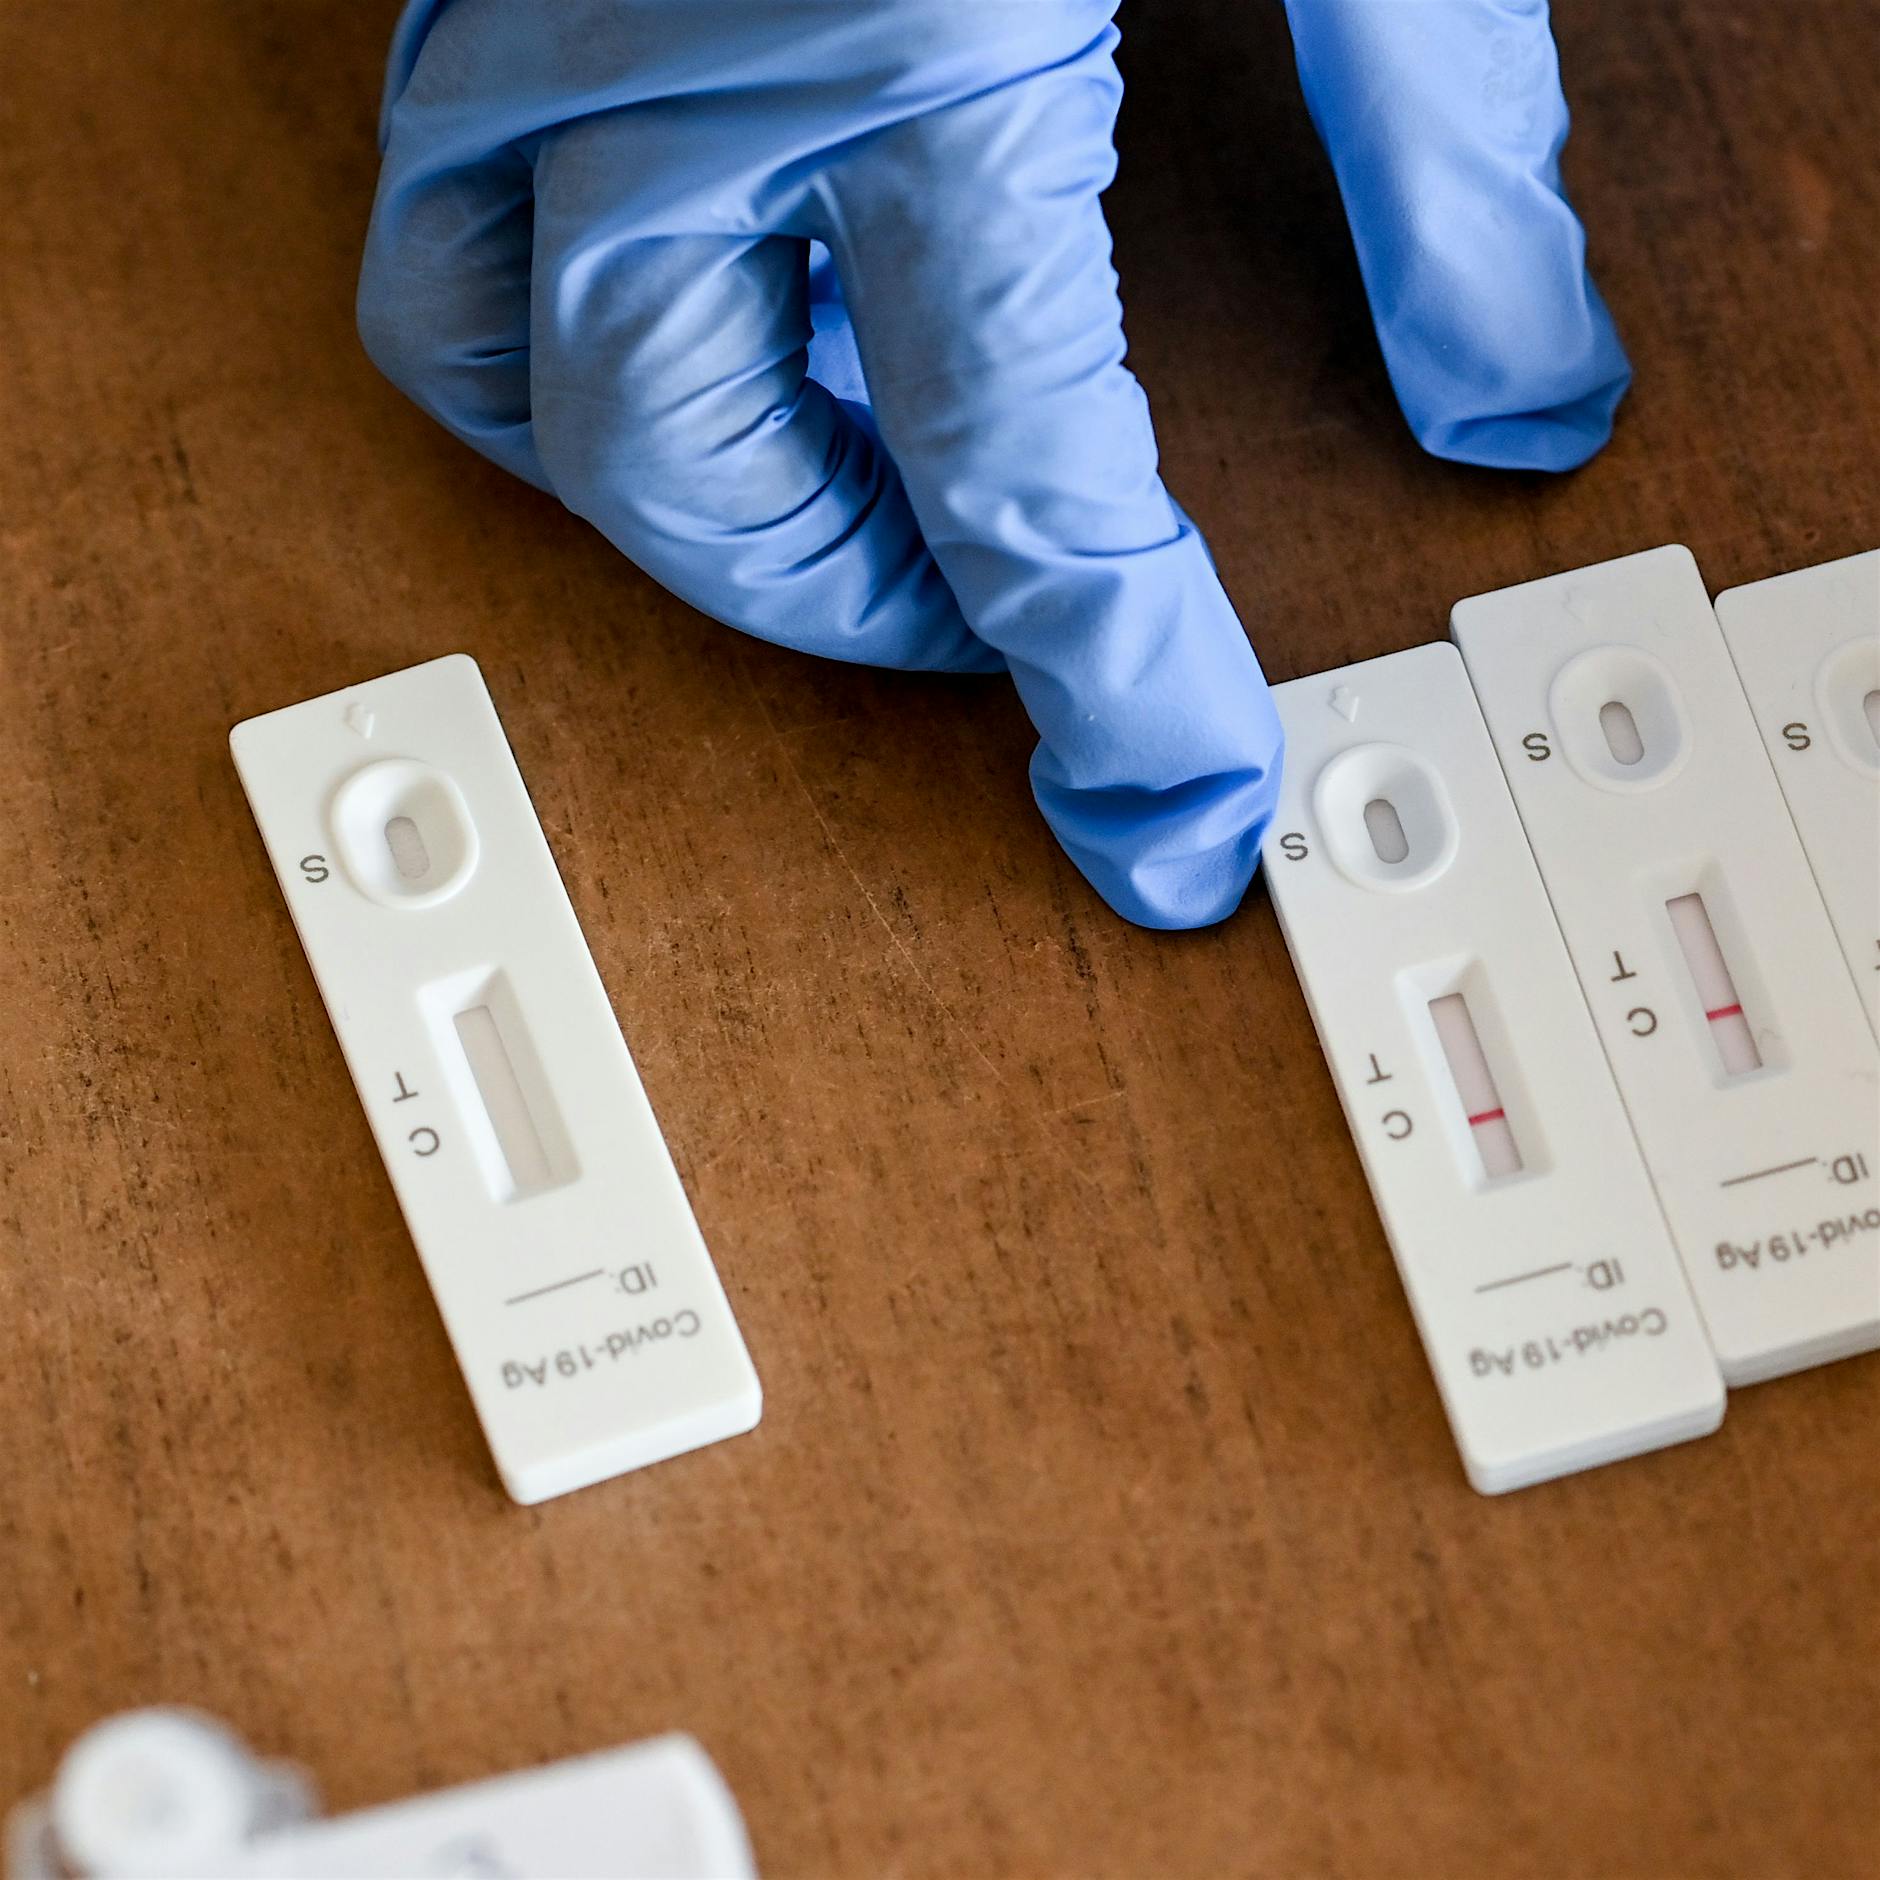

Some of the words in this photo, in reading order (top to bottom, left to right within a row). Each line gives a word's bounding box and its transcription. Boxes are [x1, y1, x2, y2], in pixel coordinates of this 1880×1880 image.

[1523, 733, 1552, 762] S
[1782, 722, 1811, 752] S
[1280, 832, 1309, 861] S
[299, 854, 330, 883] S
[1611, 950, 1637, 983] T
[1626, 1006, 1658, 1037] C
[1366, 1052, 1393, 1085] T
[392, 1071, 420, 1103] T
[1382, 1109, 1413, 1140] C
[408, 1126, 441, 1158] C
[1768, 1208, 1880, 1263] ovid-19
[1715, 1240, 1761, 1271] Ag
[554, 1308, 701, 1378] Covid-19
[1522, 1306, 1668, 1370] Covid-19
[501, 1356, 548, 1389] Ag
[1469, 1346, 1515, 1378] Ag
